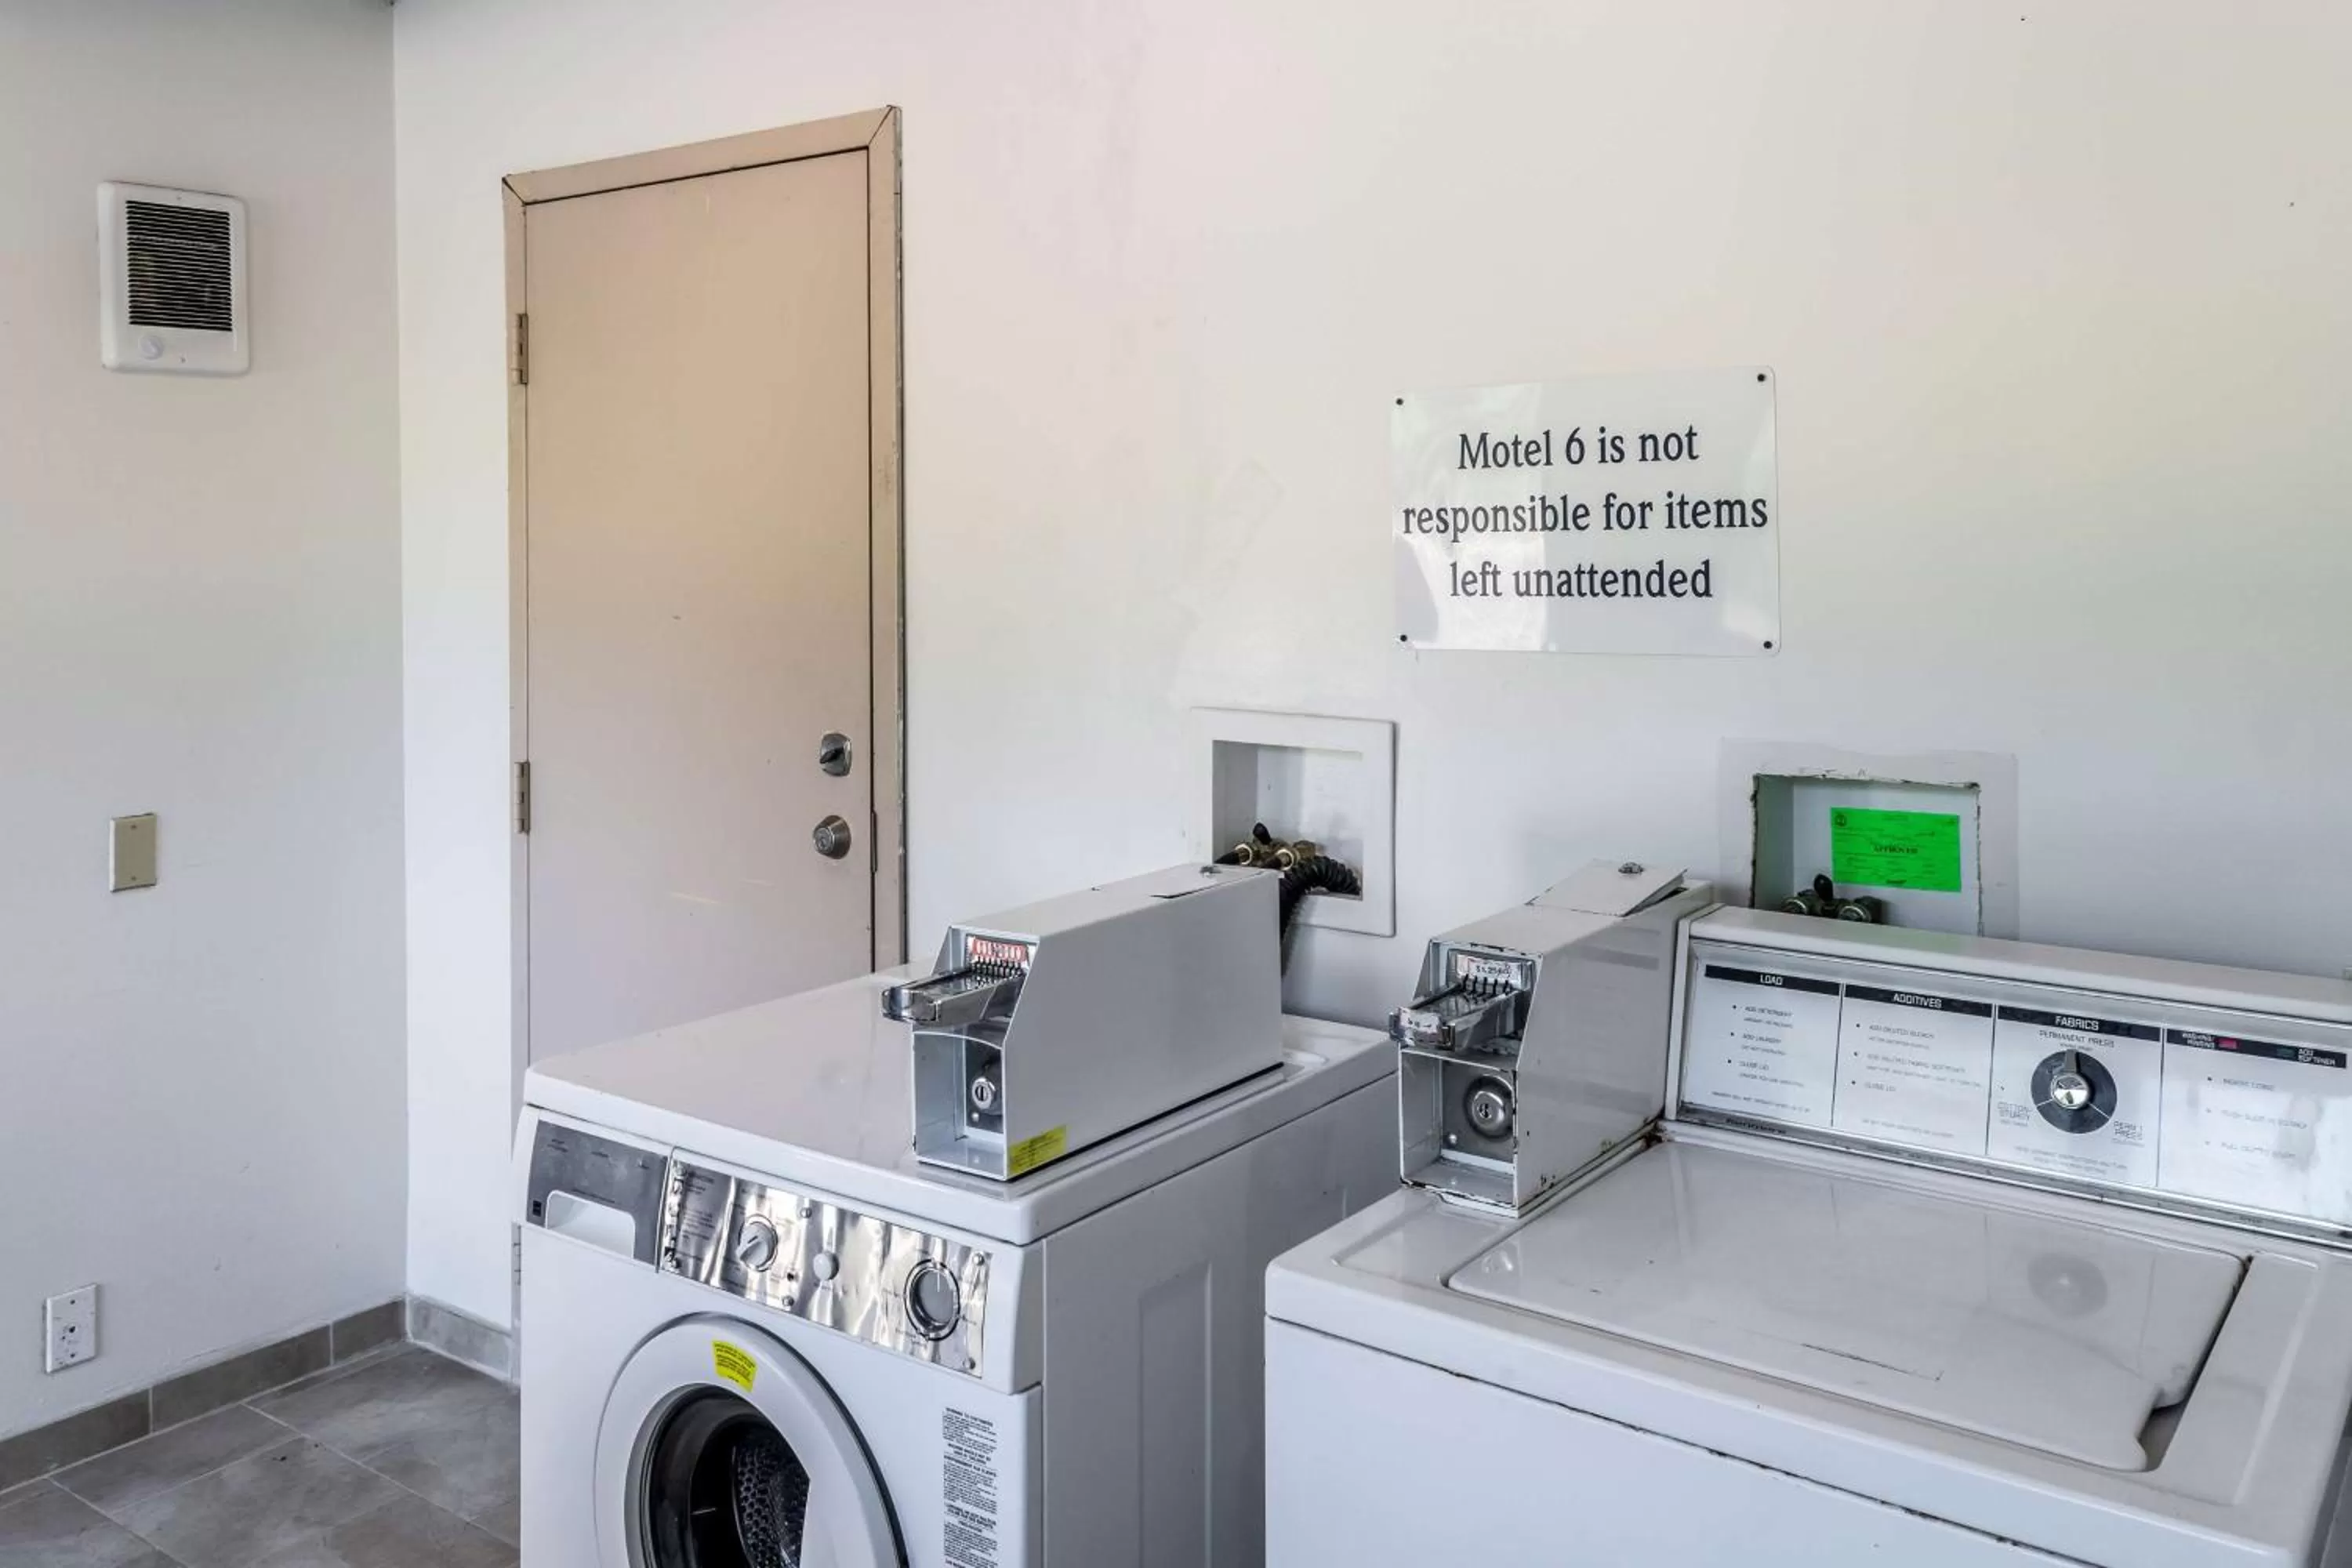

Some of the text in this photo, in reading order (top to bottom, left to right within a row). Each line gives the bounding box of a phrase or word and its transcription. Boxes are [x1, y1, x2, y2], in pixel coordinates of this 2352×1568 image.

[1457, 424, 1700, 470] Motel 6 is not
[1403, 490, 1768, 543] responsible for items
[1450, 558, 1713, 598] left unattended
[1759, 974, 1784, 986] LOAD
[1893, 993, 1942, 1009] ADDITIVES
[2055, 1015, 2099, 1031] FABRICS
